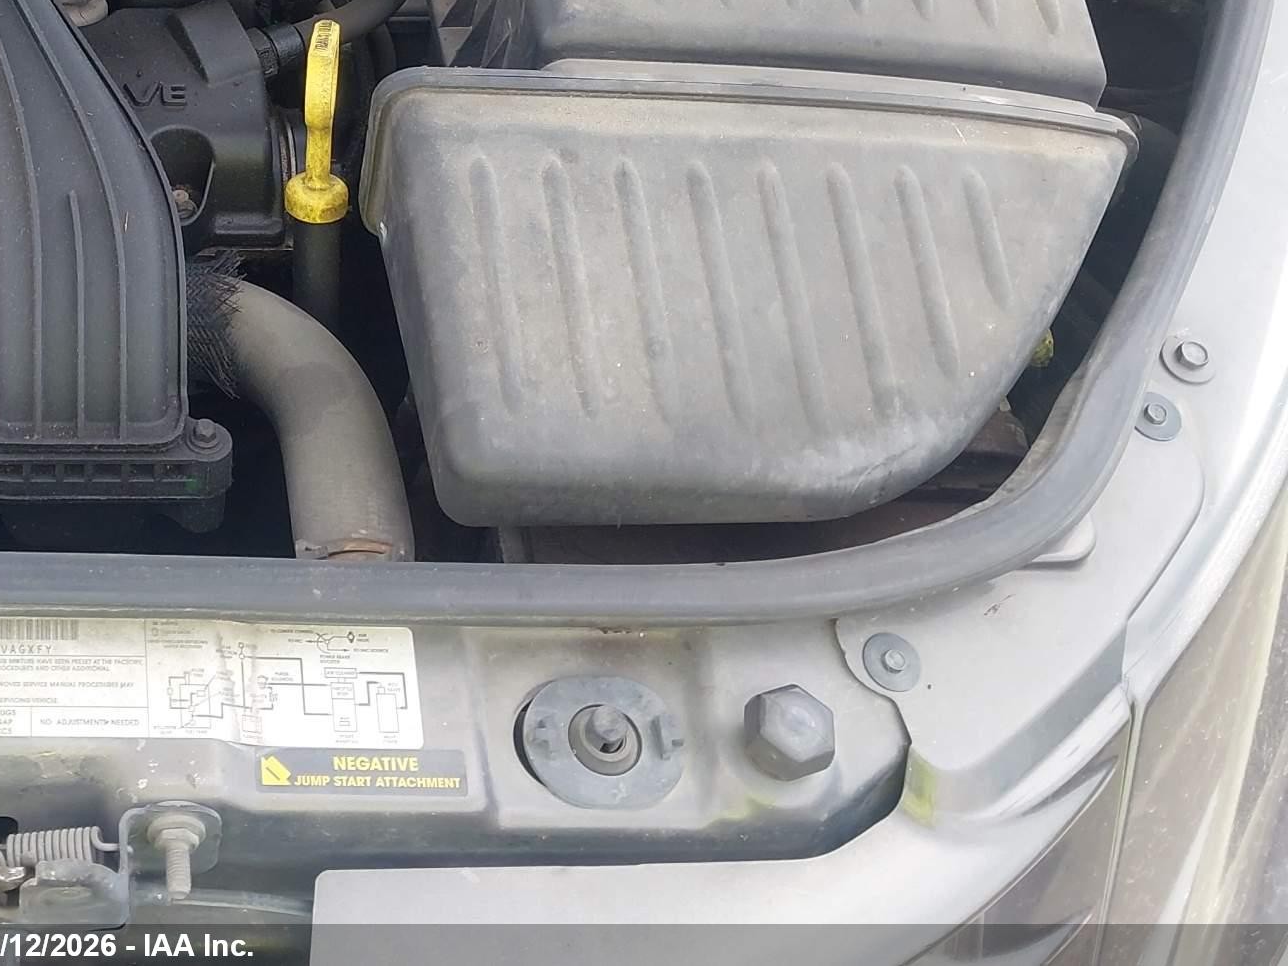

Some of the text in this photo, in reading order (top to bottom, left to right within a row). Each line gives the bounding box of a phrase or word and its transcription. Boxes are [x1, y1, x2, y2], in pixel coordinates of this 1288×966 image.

[333, 756, 419, 772] NEGATIVE
[294, 775, 461, 789] JUMP START ATTACHMENT
